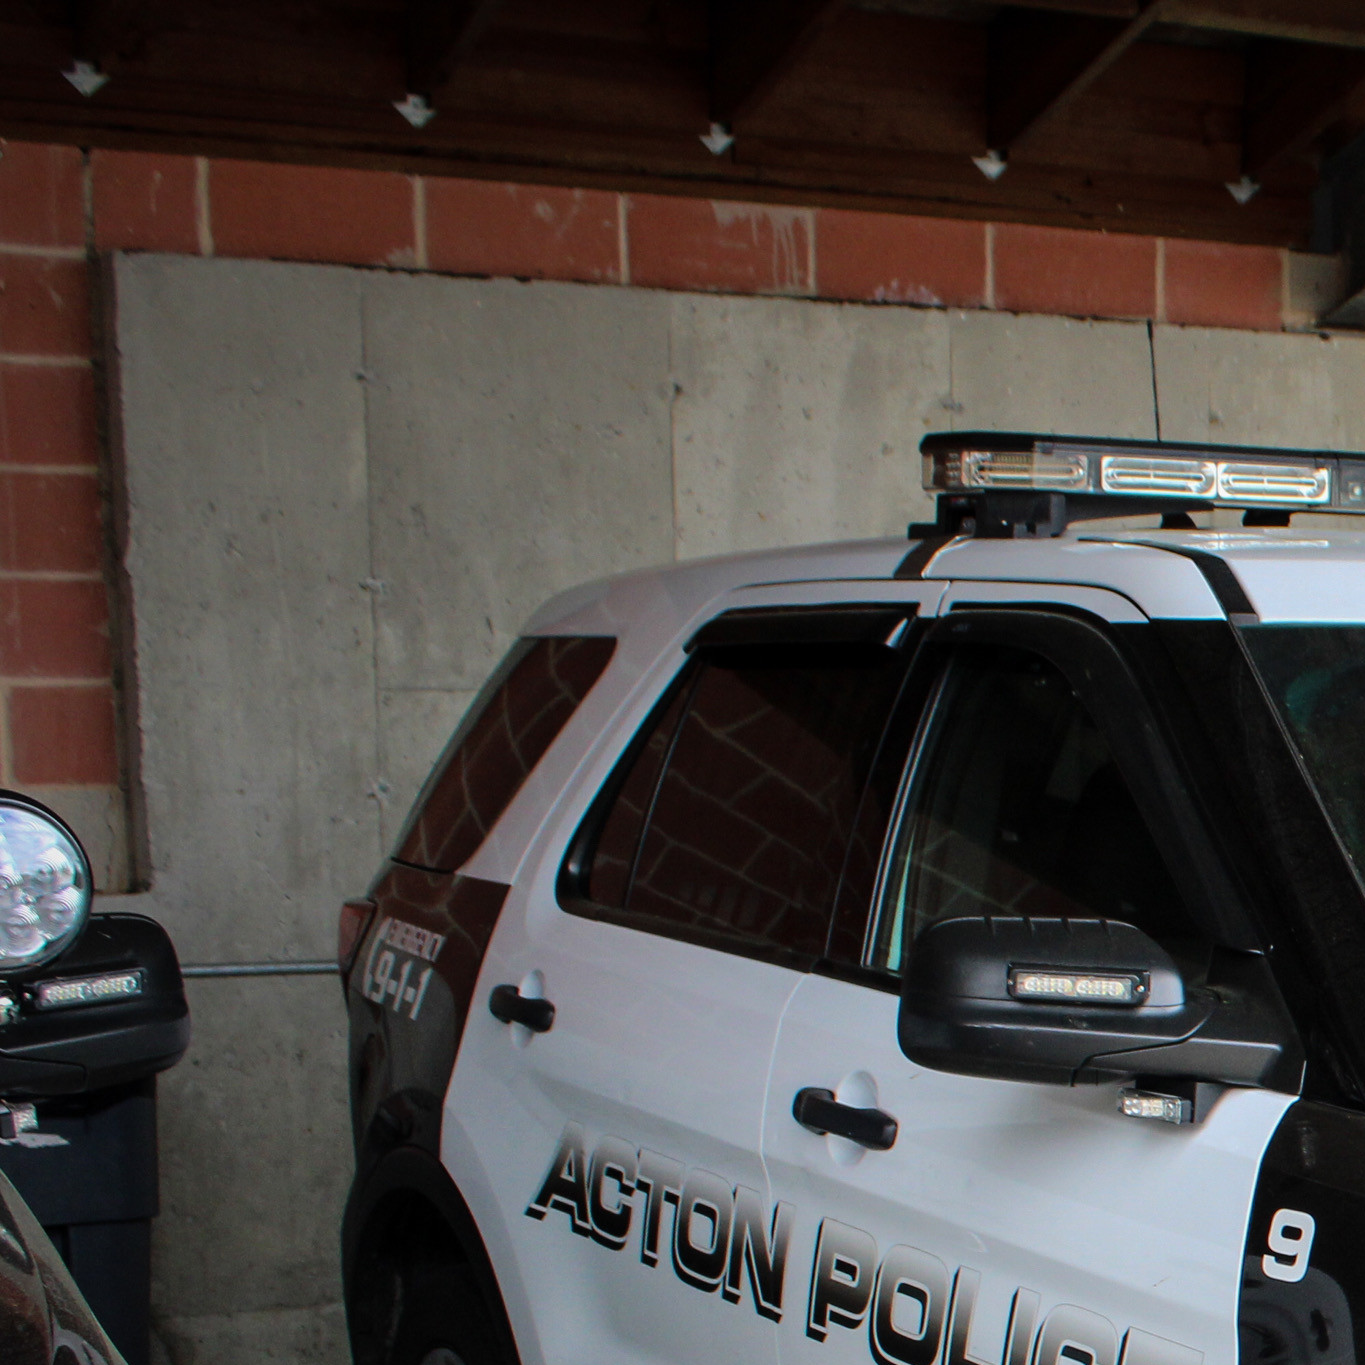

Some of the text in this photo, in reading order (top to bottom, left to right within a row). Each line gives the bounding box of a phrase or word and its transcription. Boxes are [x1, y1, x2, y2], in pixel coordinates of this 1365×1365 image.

[370, 949, 434, 1021] 9-1-1
[523, 1118, 797, 1325] ACTON
[1261, 1208, 1316, 1283] 9
